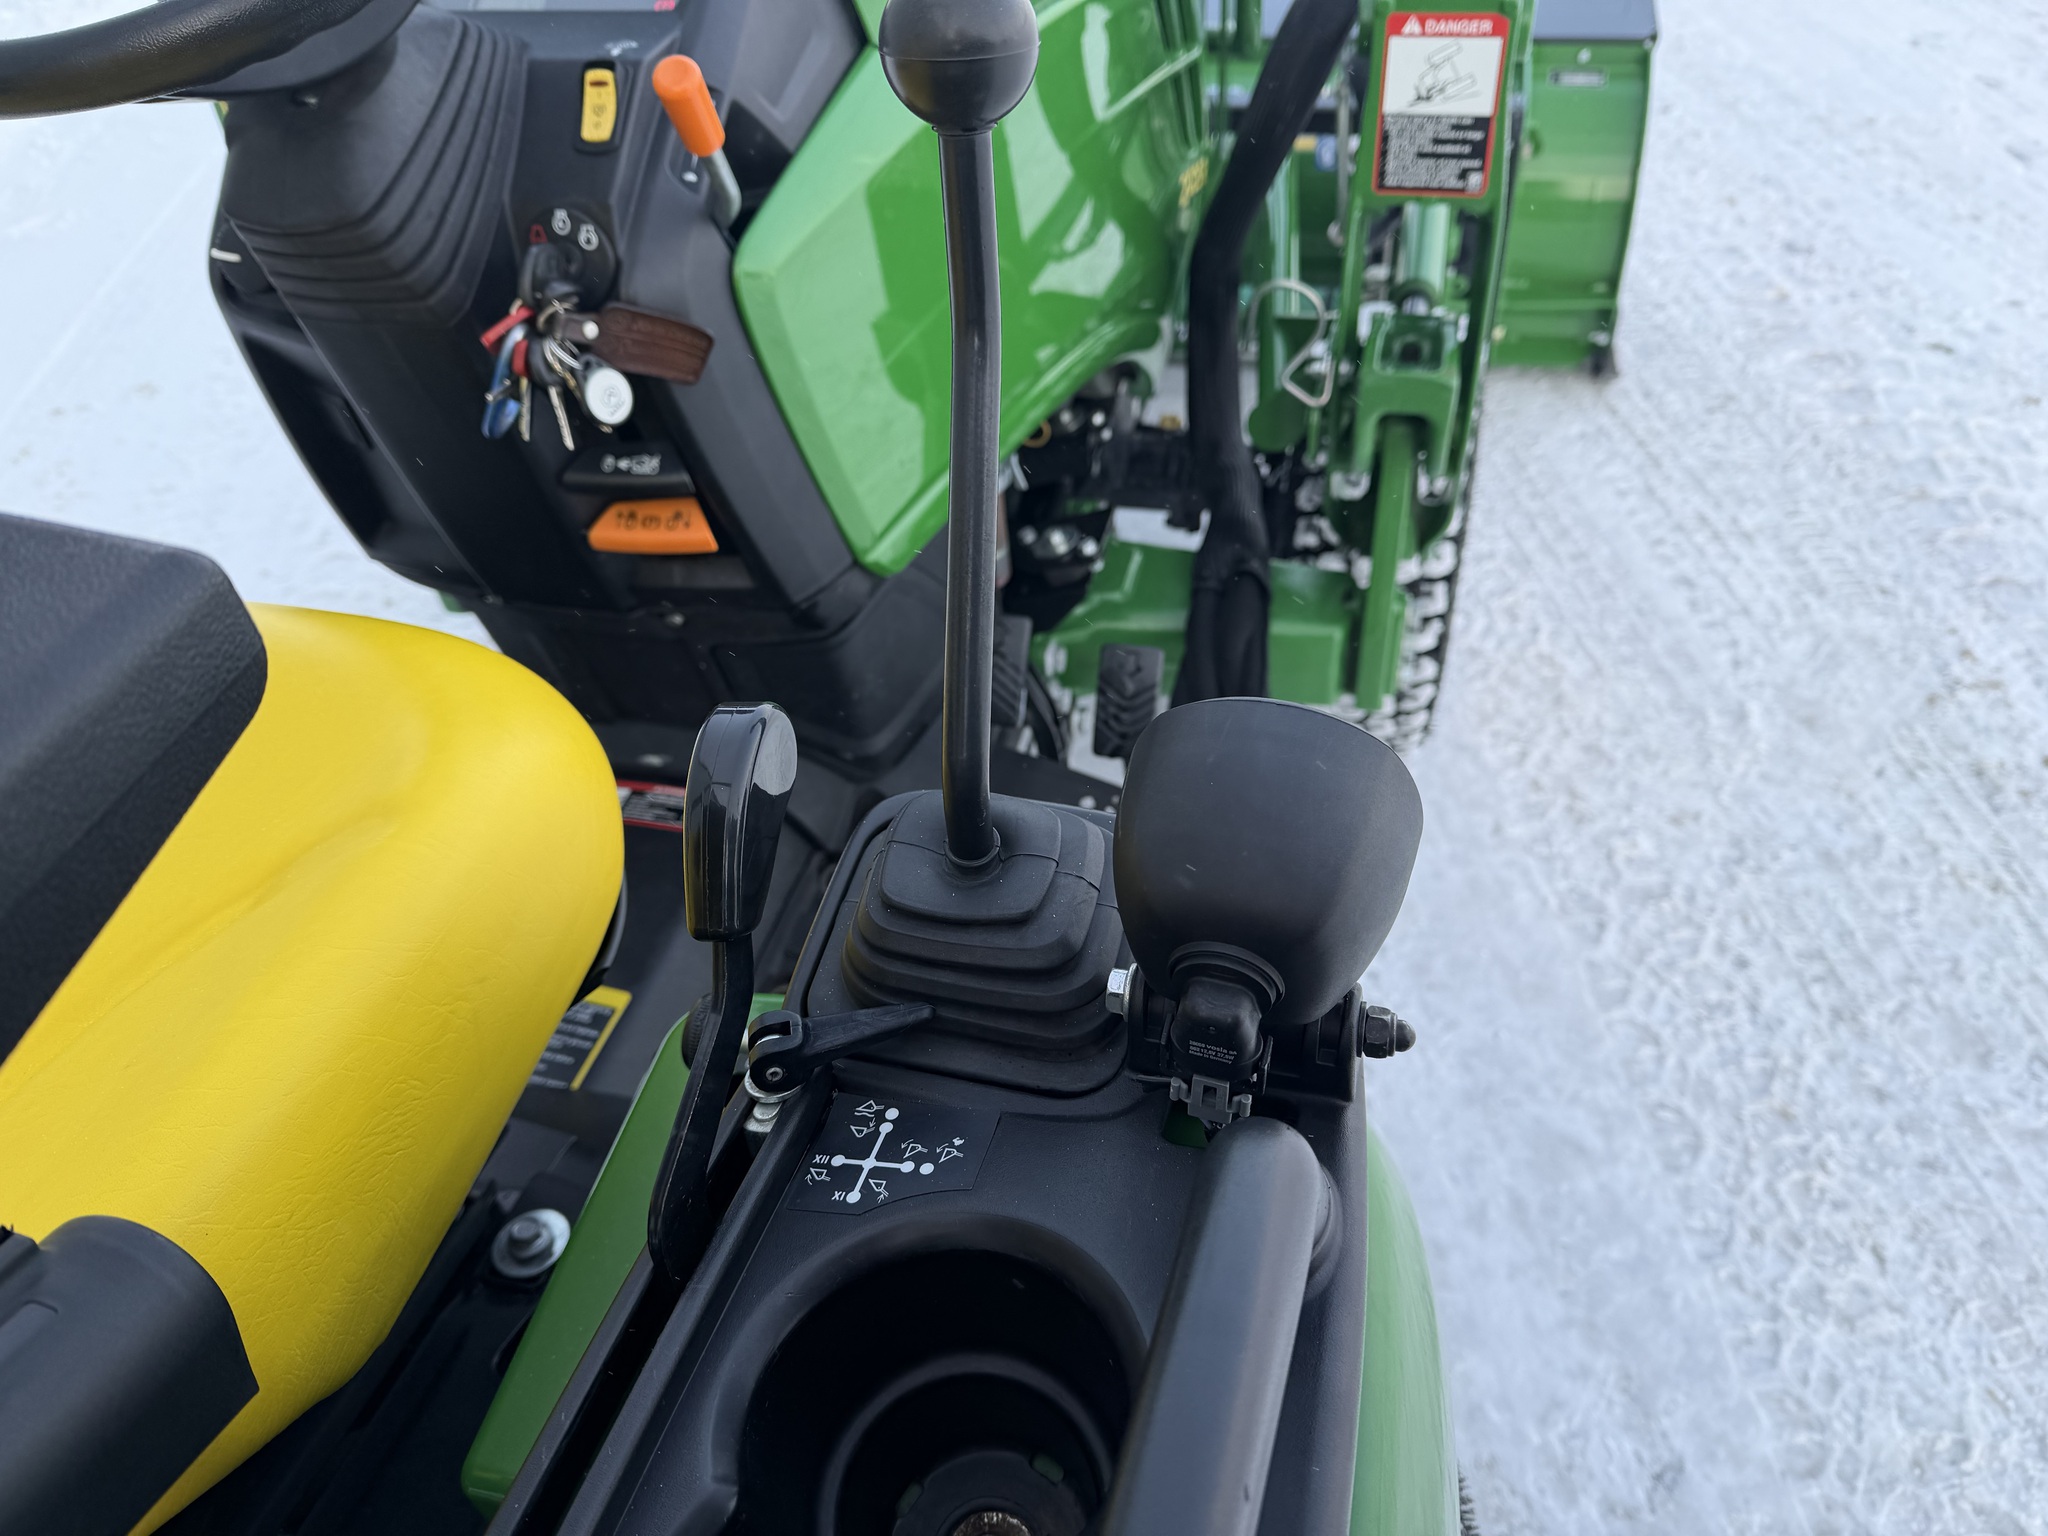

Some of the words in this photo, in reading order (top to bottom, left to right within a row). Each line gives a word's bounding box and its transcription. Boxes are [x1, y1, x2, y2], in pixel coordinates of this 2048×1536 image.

[1424, 18, 1493, 35] DANGER
[1209, 1055, 1232, 1065] Germany
[812, 1154, 830, 1164] XII
[831, 1190, 846, 1201] XI
